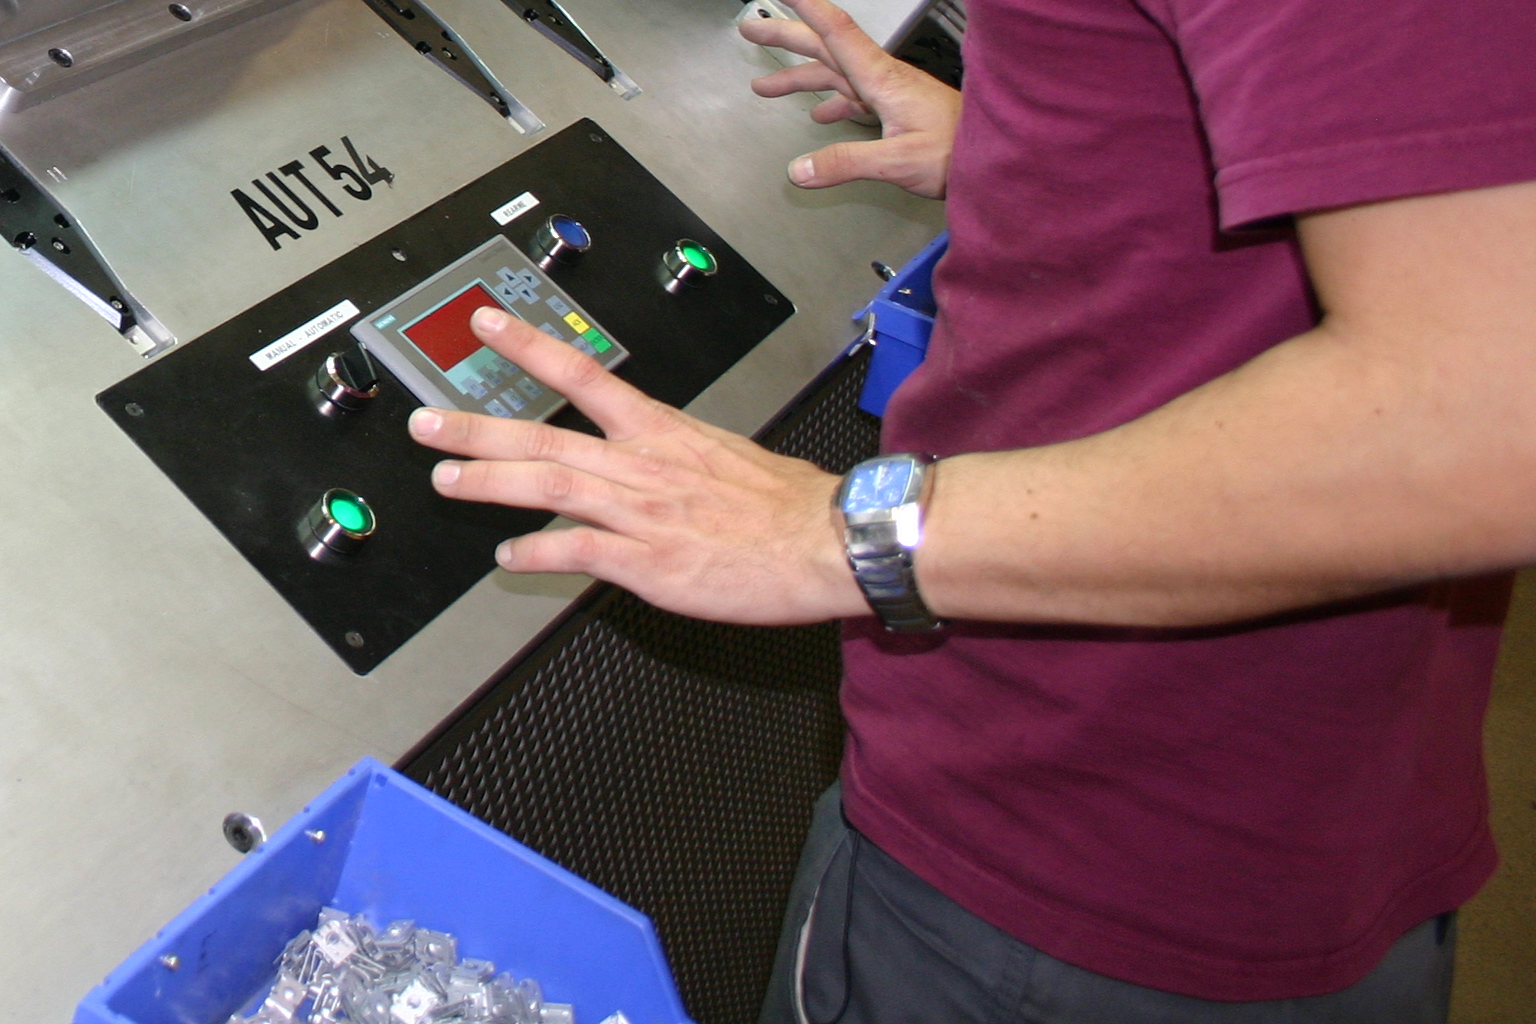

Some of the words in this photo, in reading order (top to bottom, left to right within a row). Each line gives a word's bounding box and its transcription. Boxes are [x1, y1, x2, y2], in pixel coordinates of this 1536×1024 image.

[230, 158, 344, 252] AUT
[308, 135, 395, 201] 54
[265, 339, 298, 361] MANUAL
[304, 310, 344, 338] AUTOMATIC
